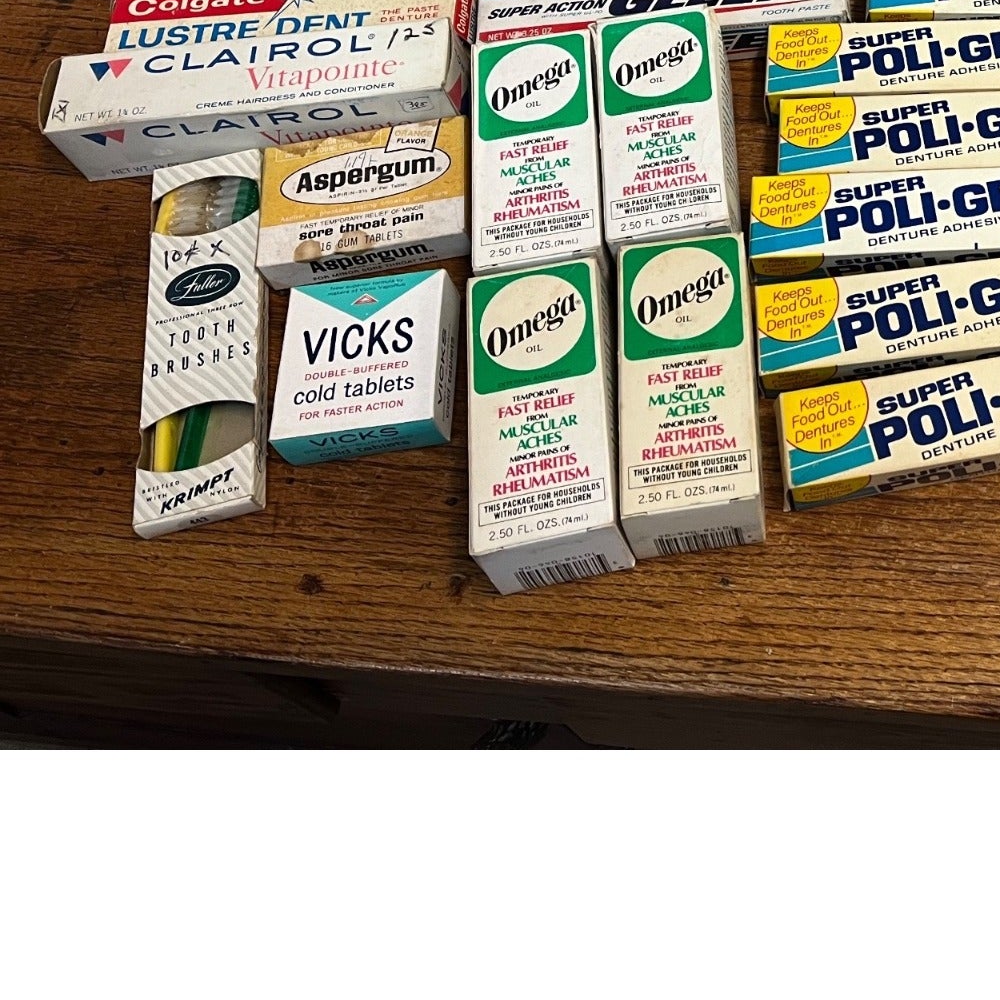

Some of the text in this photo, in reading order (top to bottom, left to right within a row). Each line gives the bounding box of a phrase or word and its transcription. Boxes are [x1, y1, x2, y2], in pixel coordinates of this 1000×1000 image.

[488, 3, 544, 19] SUPER
[118, 11, 372, 50] LUSTRE DENT
[848, 26, 933, 50] SUPER
[143, 37, 374, 74] CLAIROL
[615, 37, 695, 87] Omega
[245, 58, 398, 92] Vitapointe
[491, 57, 572, 112] Omega
[195, 82, 395, 110] CREME HAIRDRESS AND CONDITIONER
[862, 100, 950, 125] SUPER
[295, 155, 436, 194] Aspergum
[835, 175, 926, 204] SUPER
[299, 211, 424, 240] sore throat pain
[176, 273, 226, 300] Fuller
[637, 266, 725, 325] Omega
[846, 273, 940, 310] SUPER
[168, 319, 236, 347] TOOTH
[487, 292, 577, 357] Omega
[303, 317, 414, 365] VICKS
[151, 341, 252, 377] BRUSHES
[304, 361, 409, 381] DOUBLE-BUFFERED
[293, 374, 415, 406] cold tablets
[799, 390, 840, 411] Keeps
[877, 371, 974, 415] SUPER
[299, 399, 404, 420] FOR FASTER ACTION
[498, 393, 575, 419] FAST RELIEF
[791, 407, 826, 429] Food
[498, 414, 578, 440] MUSCULAR
[516, 432, 562, 451] ACHES
[794, 414, 856, 446] Dentures
[921, 432, 997, 461] DENTURE
[505, 453, 578, 478] ARTHRITIS
[160, 467, 236, 514] KRIMPT
[492, 466, 590, 496] RHEUMATISM
